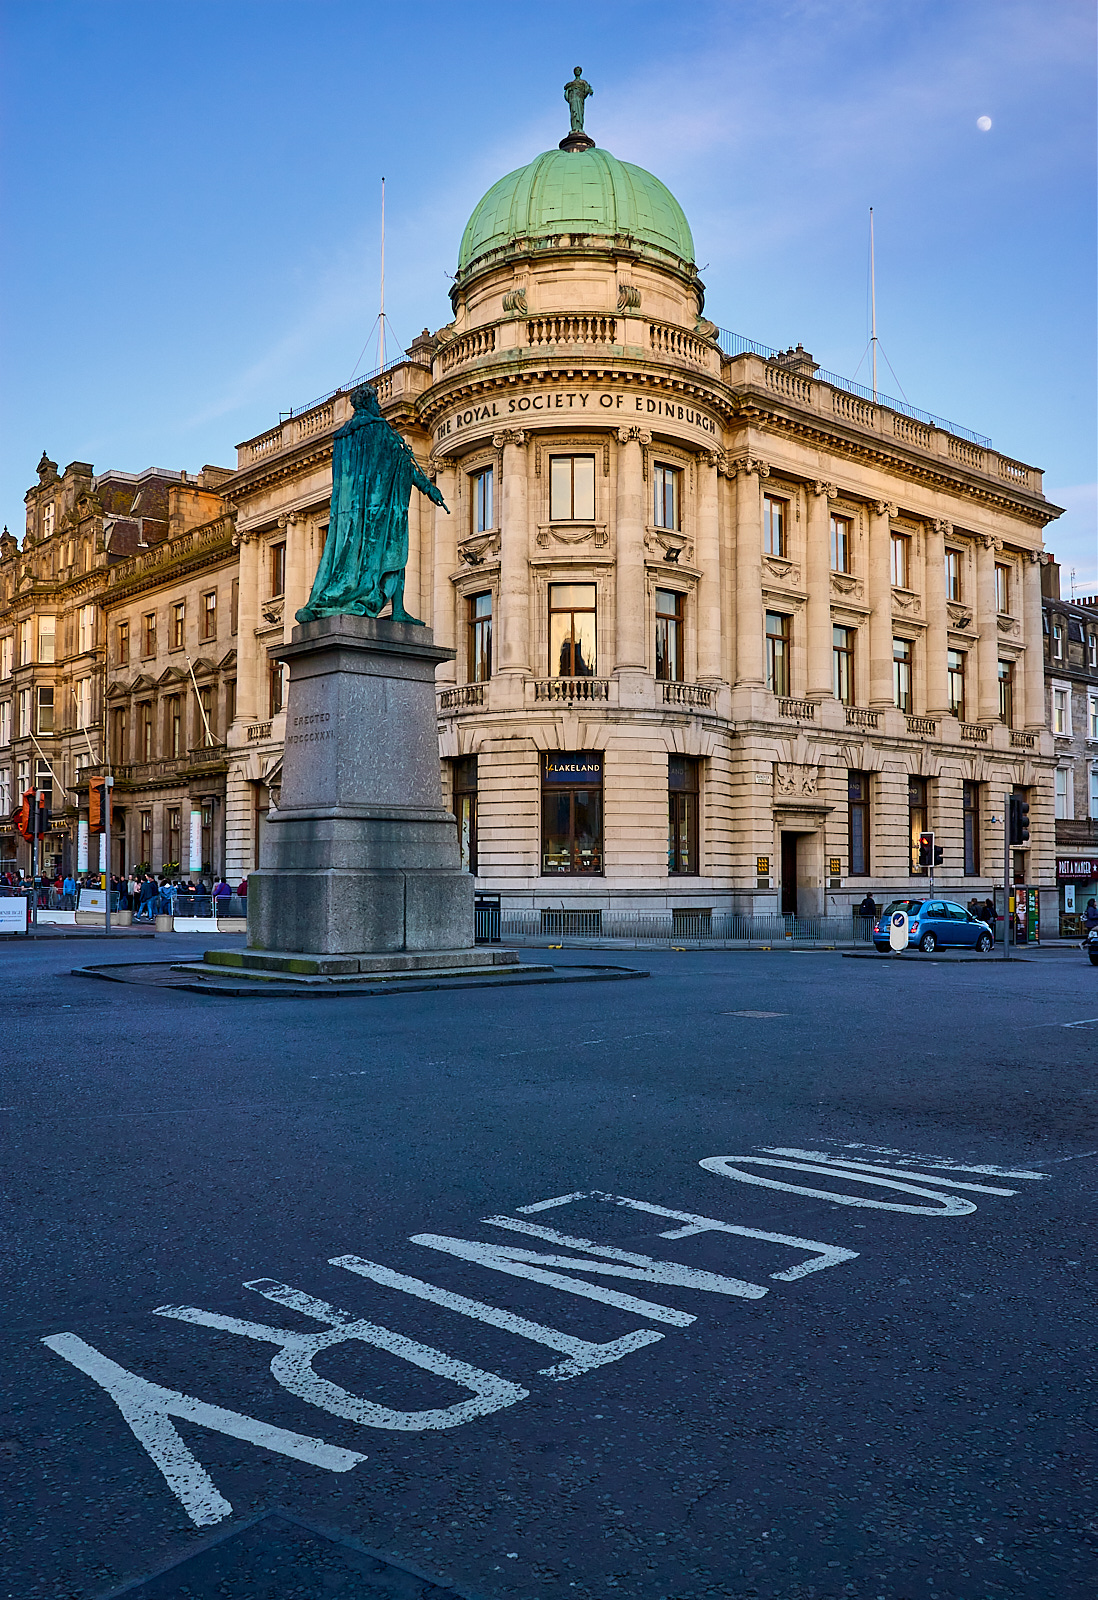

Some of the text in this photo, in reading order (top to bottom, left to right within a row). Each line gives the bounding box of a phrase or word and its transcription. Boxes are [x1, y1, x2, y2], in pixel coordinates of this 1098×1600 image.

[436, 393, 717, 441] THE ROYAL SOCIETY OF EDINBURGH
[293, 712, 331, 726] ERECTED
[554, 764, 600, 772] LAKELAND
[41, 1190, 861, 1528] ENTRY
